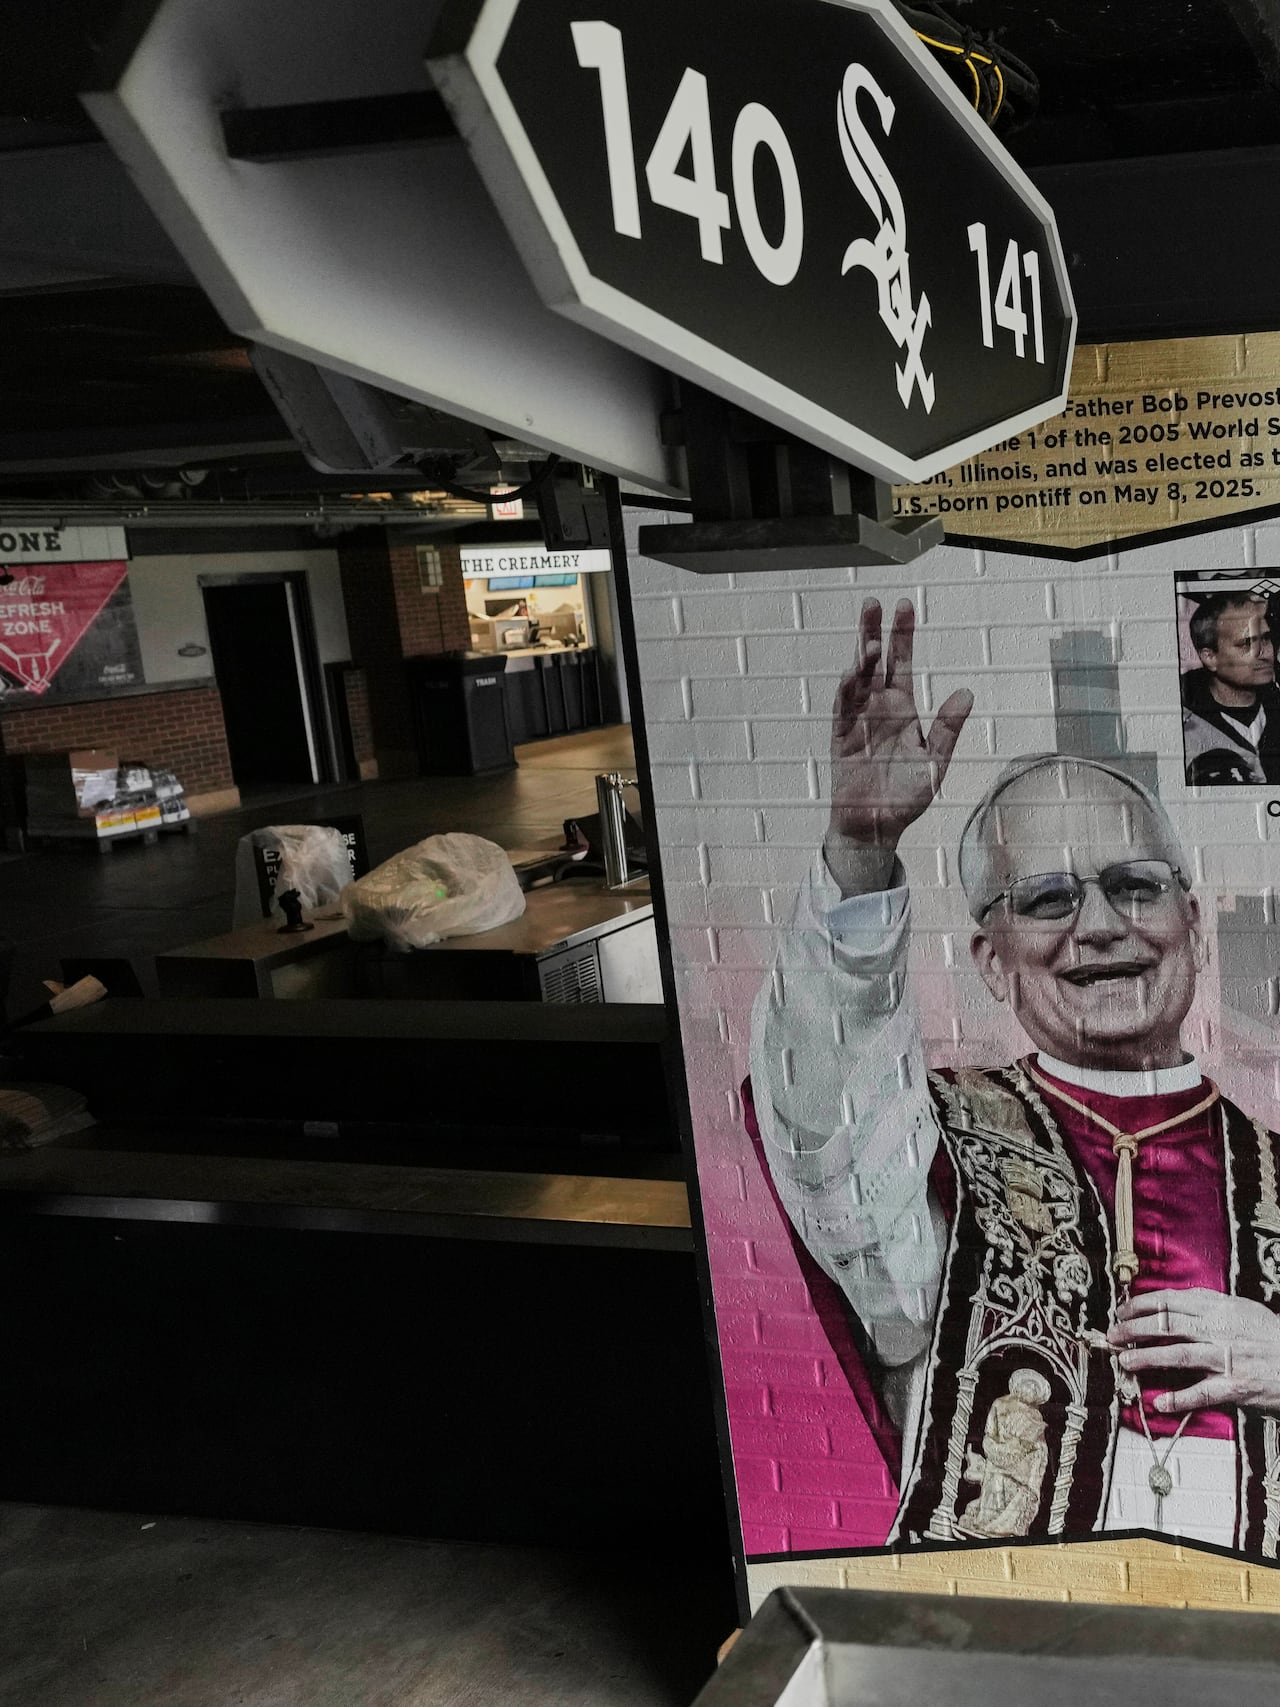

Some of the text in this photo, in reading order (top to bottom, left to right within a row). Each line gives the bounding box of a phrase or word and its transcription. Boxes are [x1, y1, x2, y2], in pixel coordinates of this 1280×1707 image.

[570, 20, 804, 286] 140
[966, 222, 1045, 365] 141
[1062, 396, 1135, 418] Father
[1142, 392, 1188, 414] Bob
[1027, 431, 1036, 450] 1
[1044, 428, 1068, 448] of
[1074, 427, 1112, 447] the
[1119, 423, 1180, 444] 2005
[1188, 417, 1259, 440] World
[960, 461, 1039, 483] Illinois,
[1045, 457, 1087, 478] and
[1095, 457, 1138, 475] was
[1145, 449, 1231, 472] elected
[1240, 452, 1264, 468] as
[996, 488, 1071, 513] pontiff
[1079, 490, 1107, 506] on
[1114, 485, 1159, 506] May
[1167, 482, 1187, 504] 8,
[1195, 478, 1261, 499] 2025.
[461, 554, 580, 573] THE CREAMERY
[0, 601, 66, 619] EFRESH
[4, 619, 53, 636] ZONE
